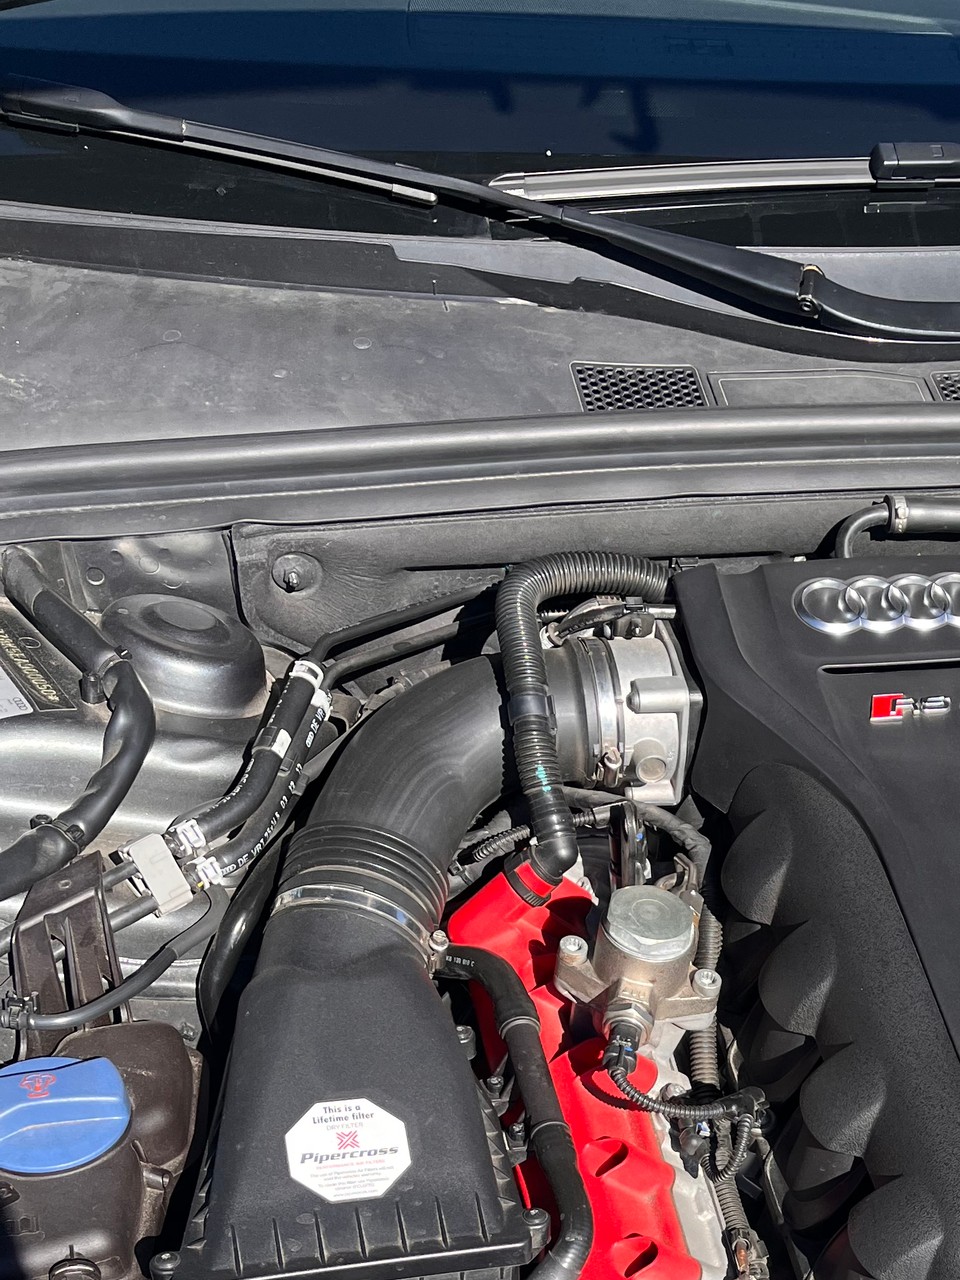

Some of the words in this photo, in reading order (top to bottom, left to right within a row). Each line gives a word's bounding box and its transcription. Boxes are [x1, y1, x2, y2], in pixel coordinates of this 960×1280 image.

[869, 692, 951, 723] RS
[323, 1106, 342, 1114] This
[312, 1115, 349, 1124] Lifetime
[352, 1112, 374, 1120] filter
[300, 1146, 399, 1164] Pipercross
